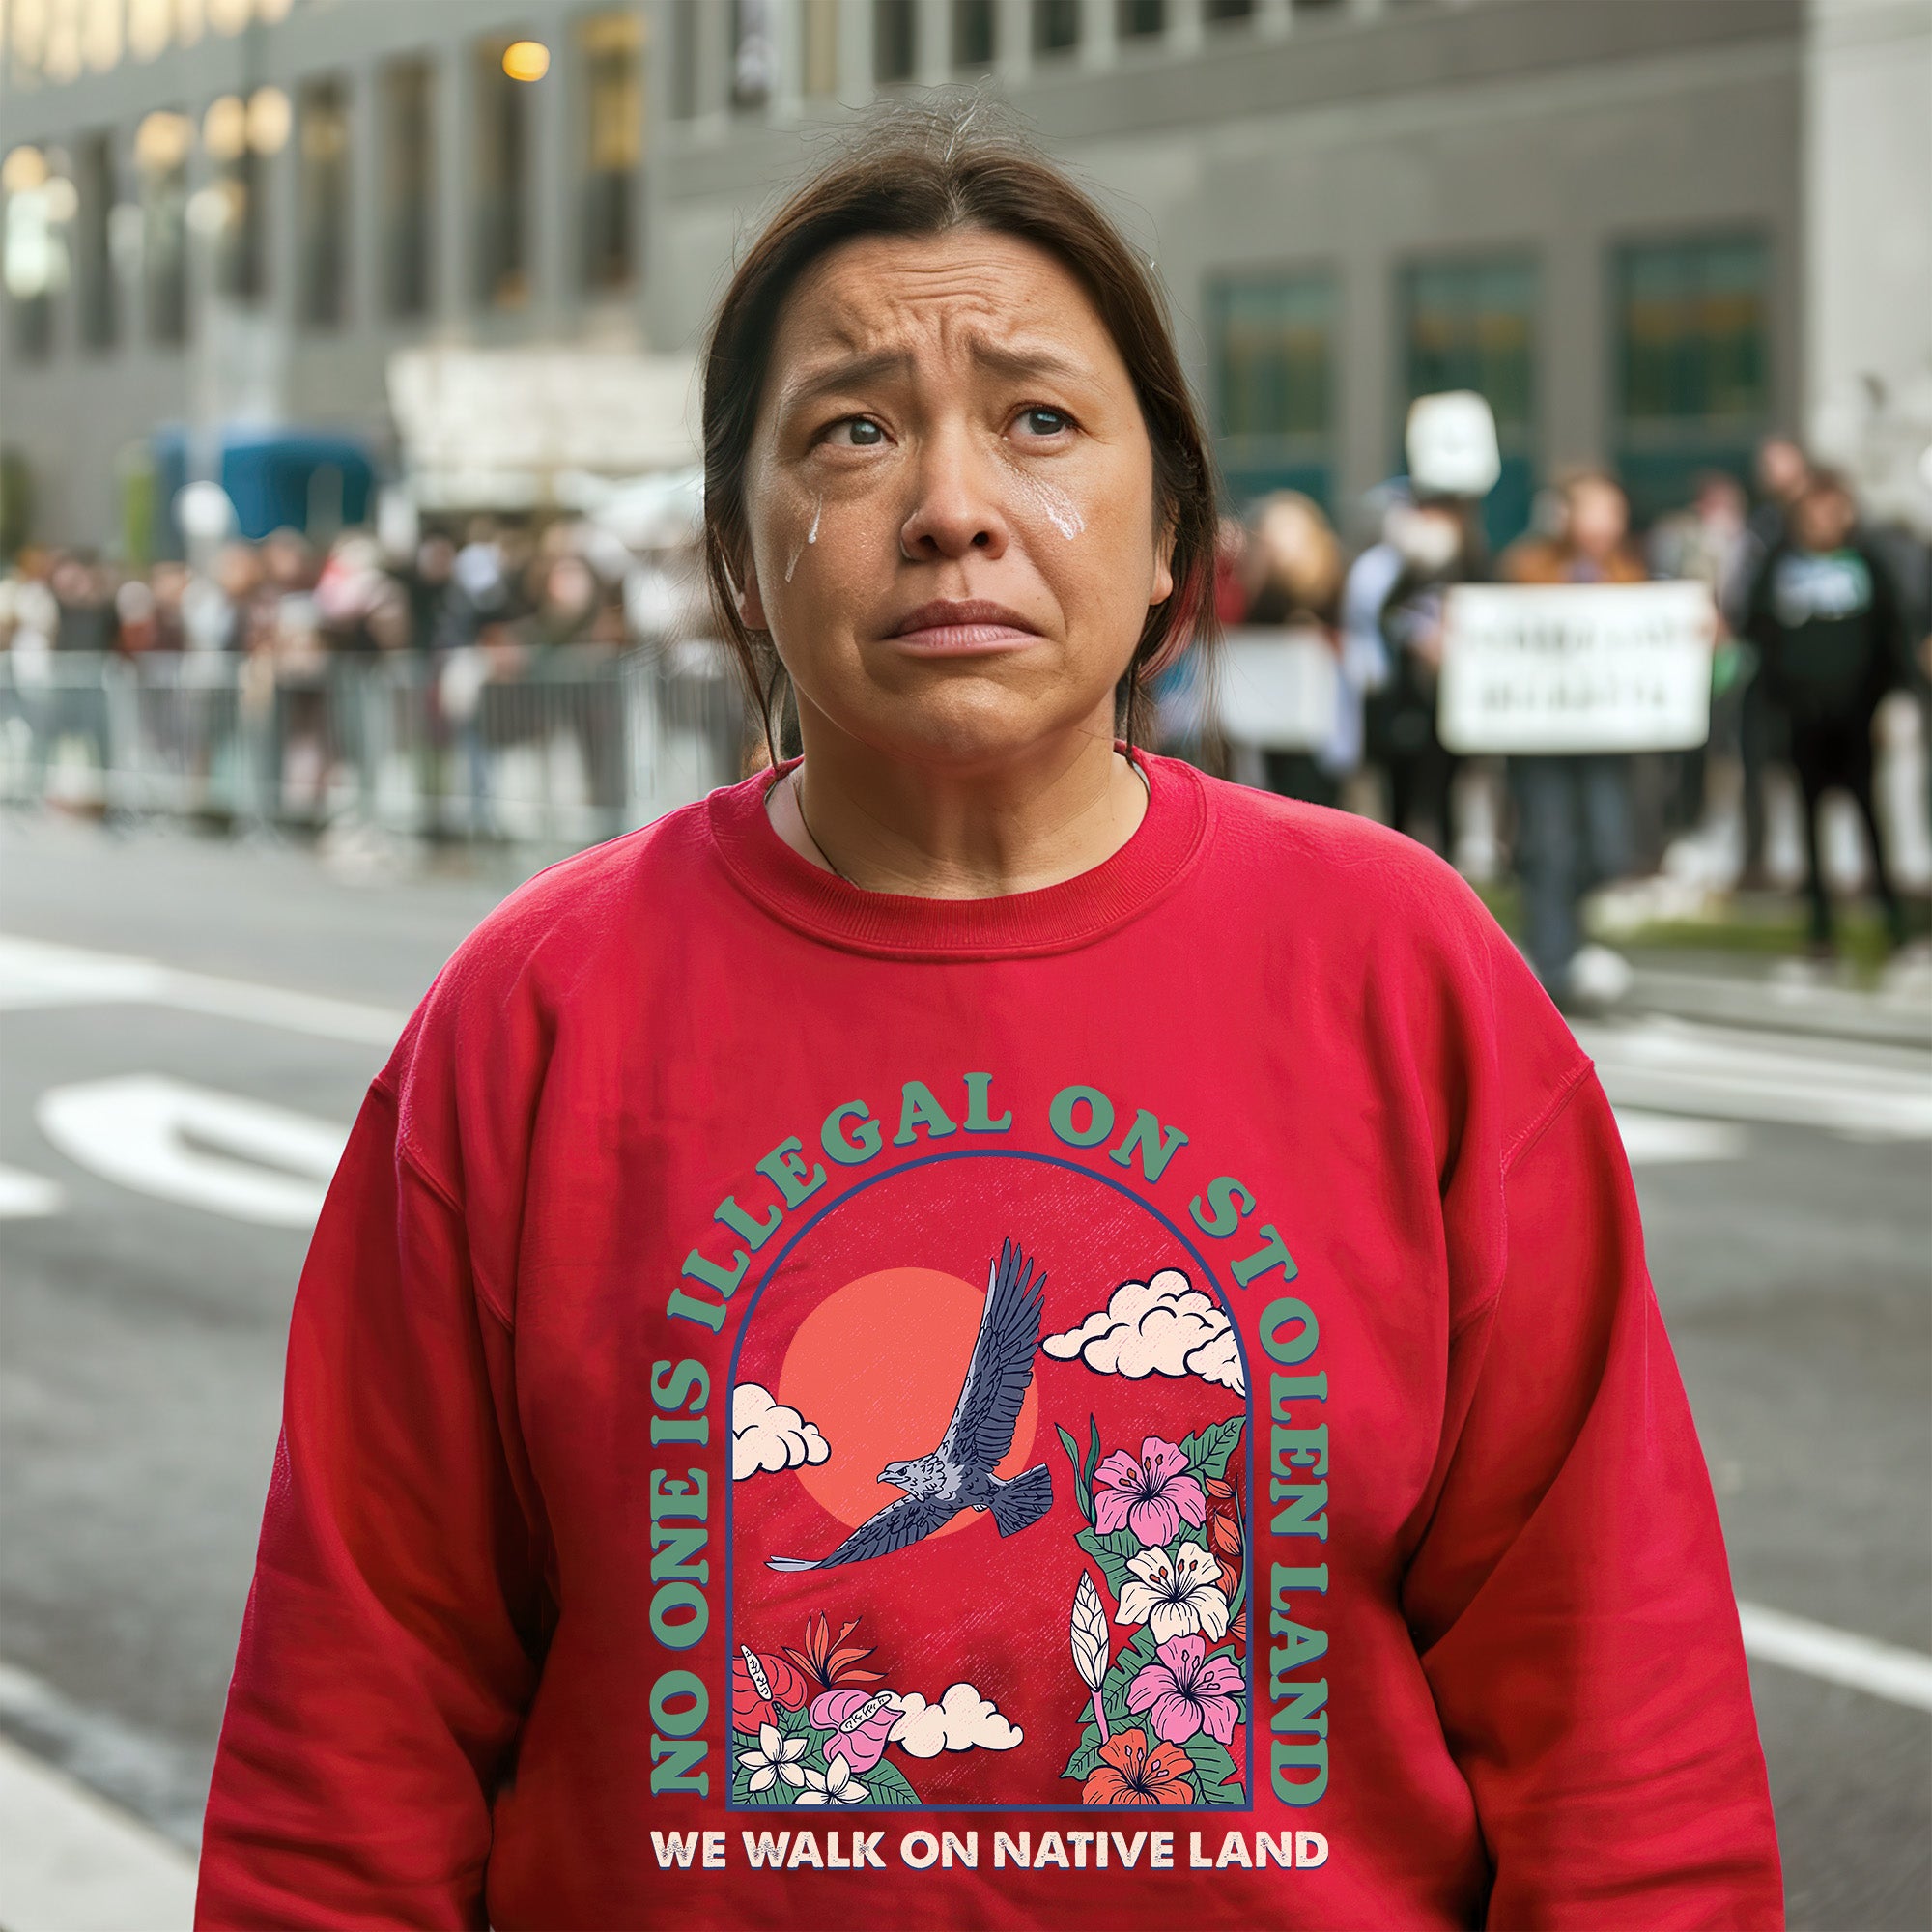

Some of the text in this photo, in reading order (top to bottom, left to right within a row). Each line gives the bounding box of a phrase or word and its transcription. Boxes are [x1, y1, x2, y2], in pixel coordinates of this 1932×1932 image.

[650, 1072, 1329, 1807] NO ONE IS ILLEGAL ON STOLEN LAND
[650, 1830, 1330, 1870] WE WALK ON NATIVE LAND
